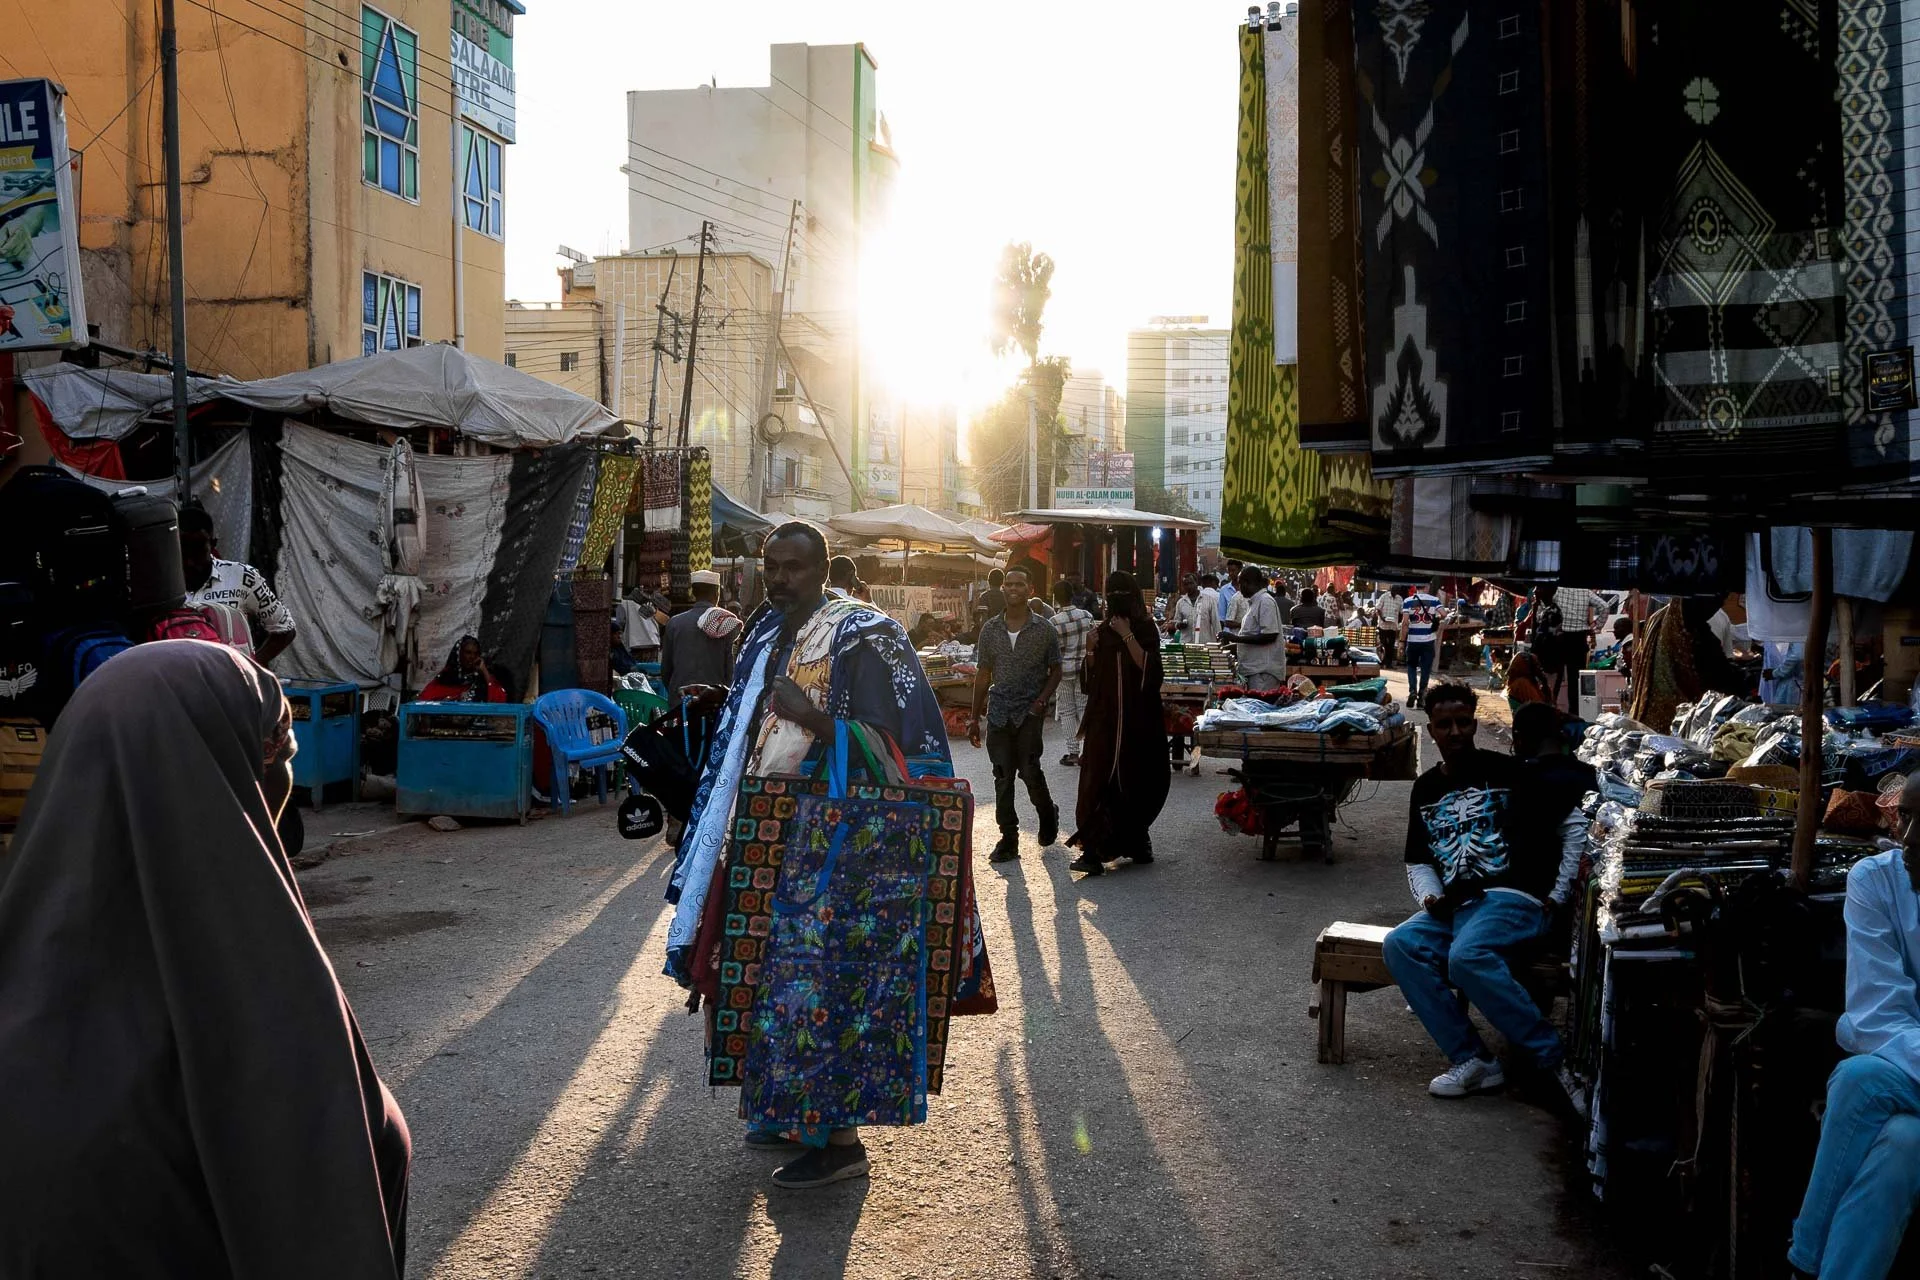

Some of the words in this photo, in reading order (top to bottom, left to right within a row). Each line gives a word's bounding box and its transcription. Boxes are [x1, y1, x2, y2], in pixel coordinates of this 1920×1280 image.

[450, 30, 513, 95] SALAAM
[0, 155, 27, 168] tion
[1110, 490, 1133, 499] ONLINE
[204, 589, 250, 601] GIVENCHY
